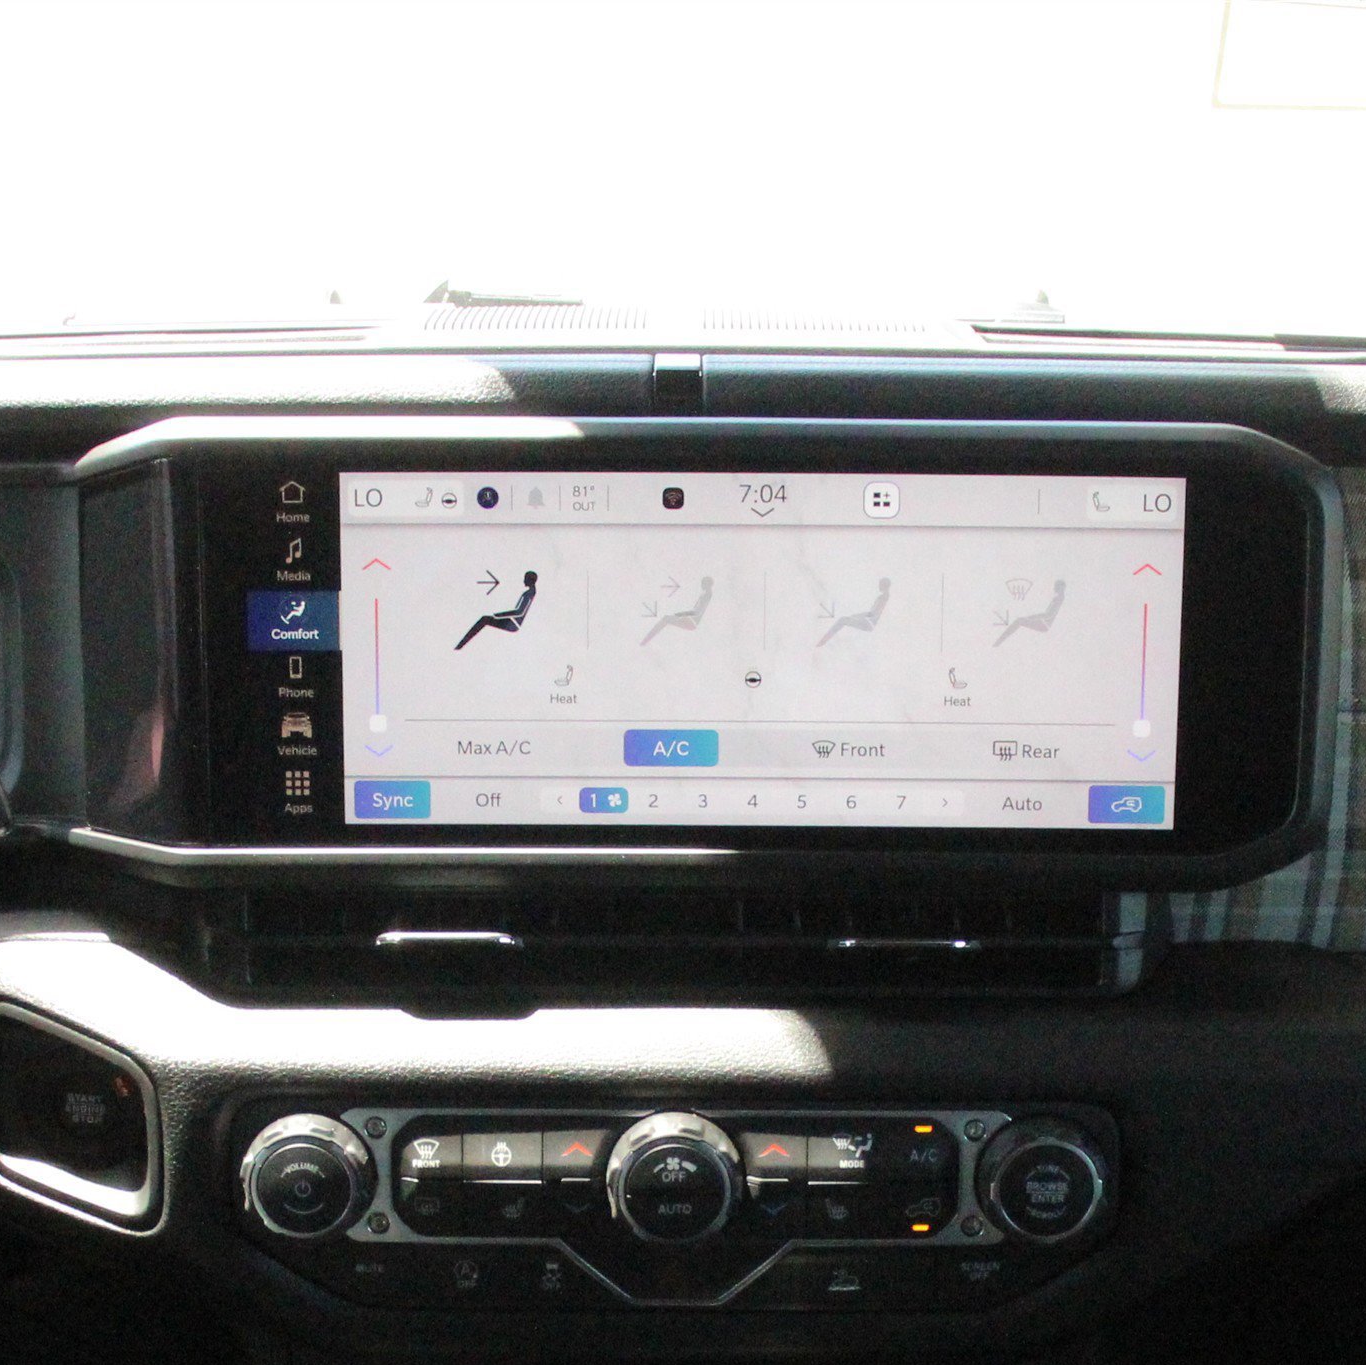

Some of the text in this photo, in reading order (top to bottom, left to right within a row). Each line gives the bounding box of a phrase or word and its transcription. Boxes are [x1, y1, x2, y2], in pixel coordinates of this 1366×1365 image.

[354, 489, 383, 508] LO
[739, 484, 788, 503] 7:04
[572, 500, 596, 512] OUT
[1142, 494, 1172, 512] LO
[276, 511, 310, 523] Home
[276, 570, 311, 581] Media
[271, 628, 319, 640] Comfort
[278, 687, 314, 699] Phone
[550, 693, 578, 705] Heat
[944, 696, 971, 707] Heat
[277, 744, 317, 756] Vehicle
[458, 739, 532, 757] Max A/C
[653, 739, 690, 758] A/C
[840, 742, 886, 758] Front
[1022, 743, 1060, 759] Rear
[372, 793, 414, 811] Sync
[475, 792, 502, 808] Off
[647, 794, 659, 808] 2
[697, 794, 708, 809] 3
[747, 794, 759, 809] 4
[796, 795, 807, 810] 5
[845, 795, 857, 810] 6
[895, 795, 906, 810] 7
[1001, 796, 1043, 812] Auto
[284, 802, 313, 815] Apps
[910, 1149, 938, 1163] A/C
[412, 1159, 440, 1169] FRONT
[839, 1160, 865, 1169] MODE
[662, 1172, 686, 1182] OFF
[657, 1204, 692, 1215] AUTO
